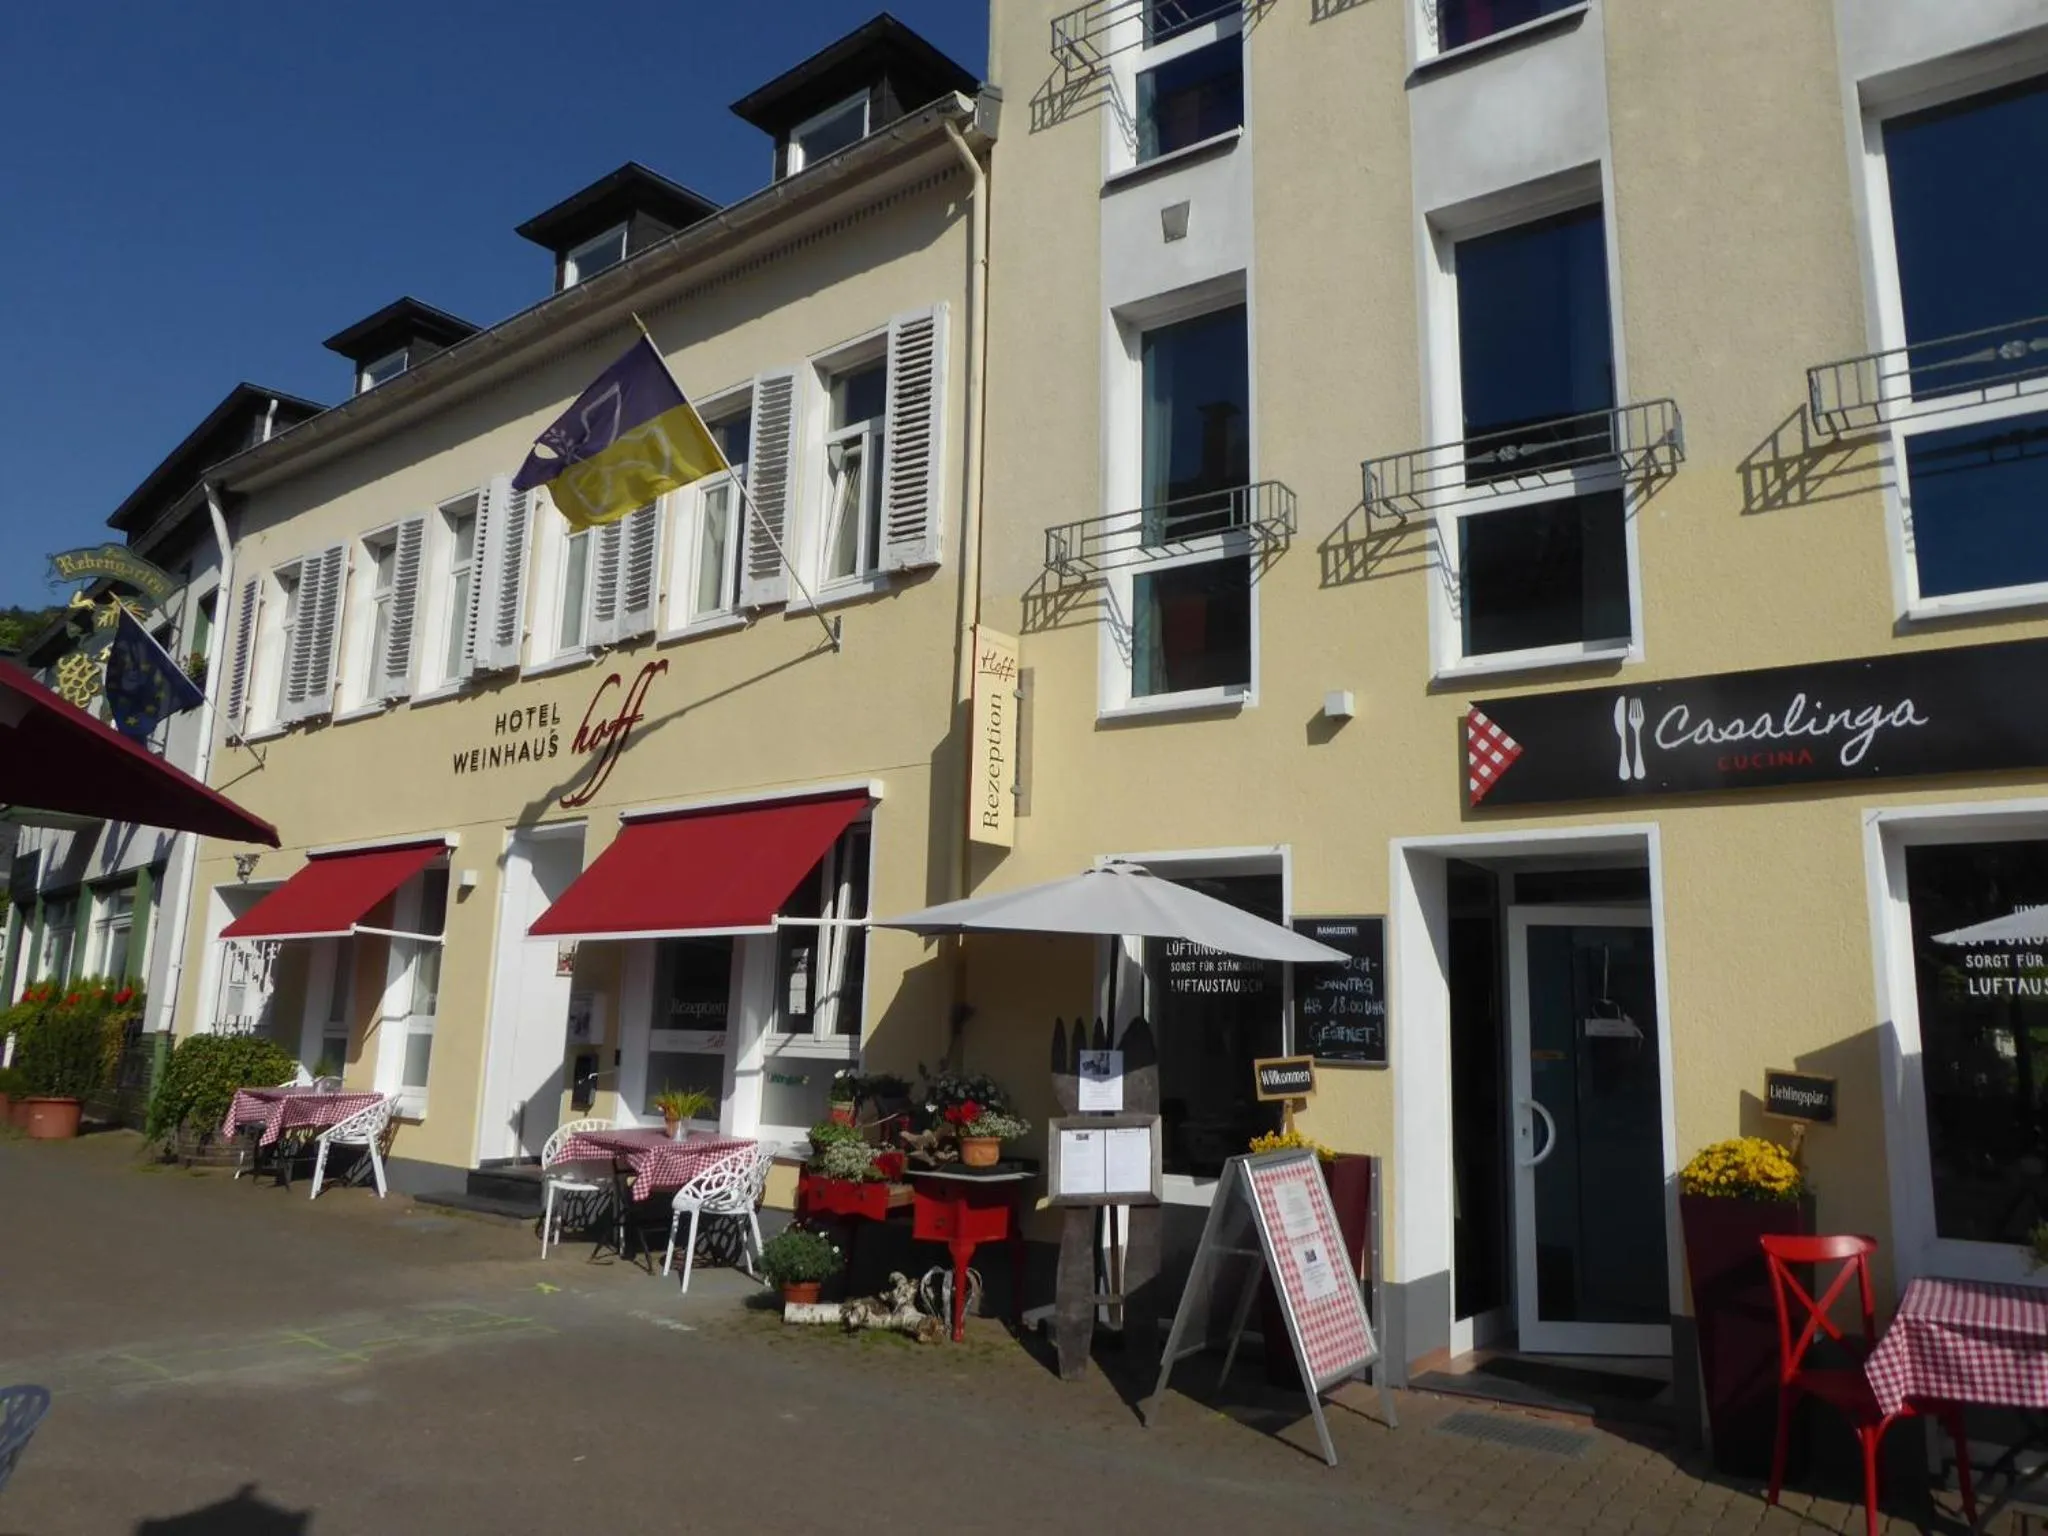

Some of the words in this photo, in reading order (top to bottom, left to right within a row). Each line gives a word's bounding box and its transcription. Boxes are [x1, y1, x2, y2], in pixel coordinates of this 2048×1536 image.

[495, 703, 560, 736] HOTEL
[1655, 693, 1928, 766] Casalinga
[453, 735, 559, 775] WEINHAUS
[982, 694, 1004, 829] Rezeption
[1717, 749, 1814, 771] CUCINA
[1170, 961, 1196, 972] SORGT
[1199, 960, 1215, 972] FÜR
[1966, 954, 2010, 969] SORGT
[2017, 952, 2044, 968] FÜR
[1304, 998, 1322, 1015] AB
[1261, 1069, 1311, 1086] Willkommen
